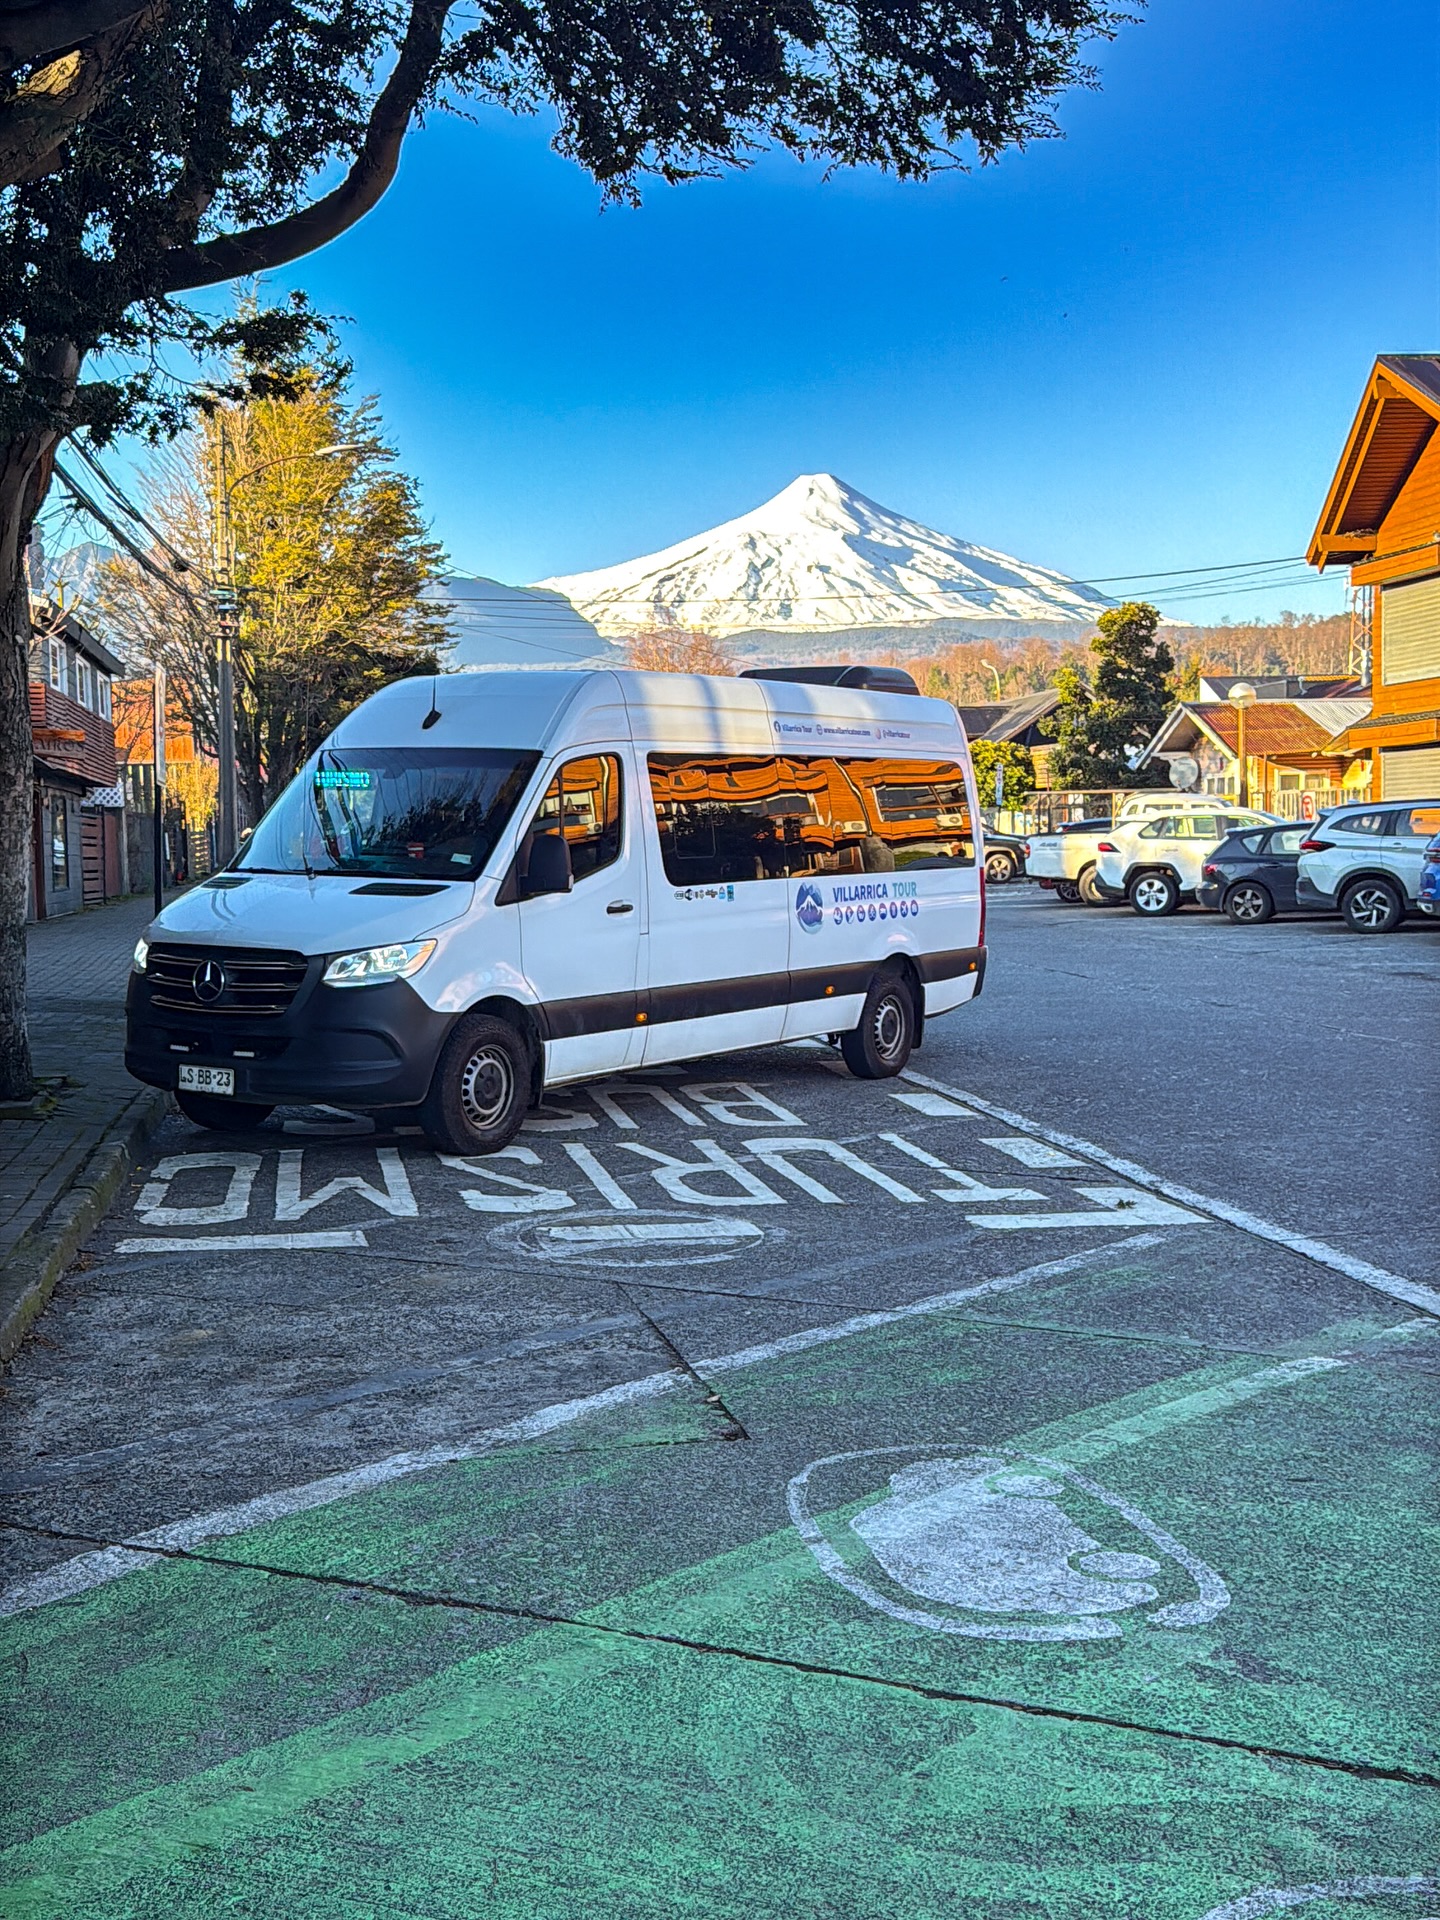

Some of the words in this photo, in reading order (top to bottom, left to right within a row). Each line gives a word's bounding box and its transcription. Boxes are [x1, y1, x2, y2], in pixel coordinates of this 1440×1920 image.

[832, 883, 888, 903] VILLARRICA
[892, 881, 918, 898] TOUR
[132, 1132, 1051, 1227] TURISMO
